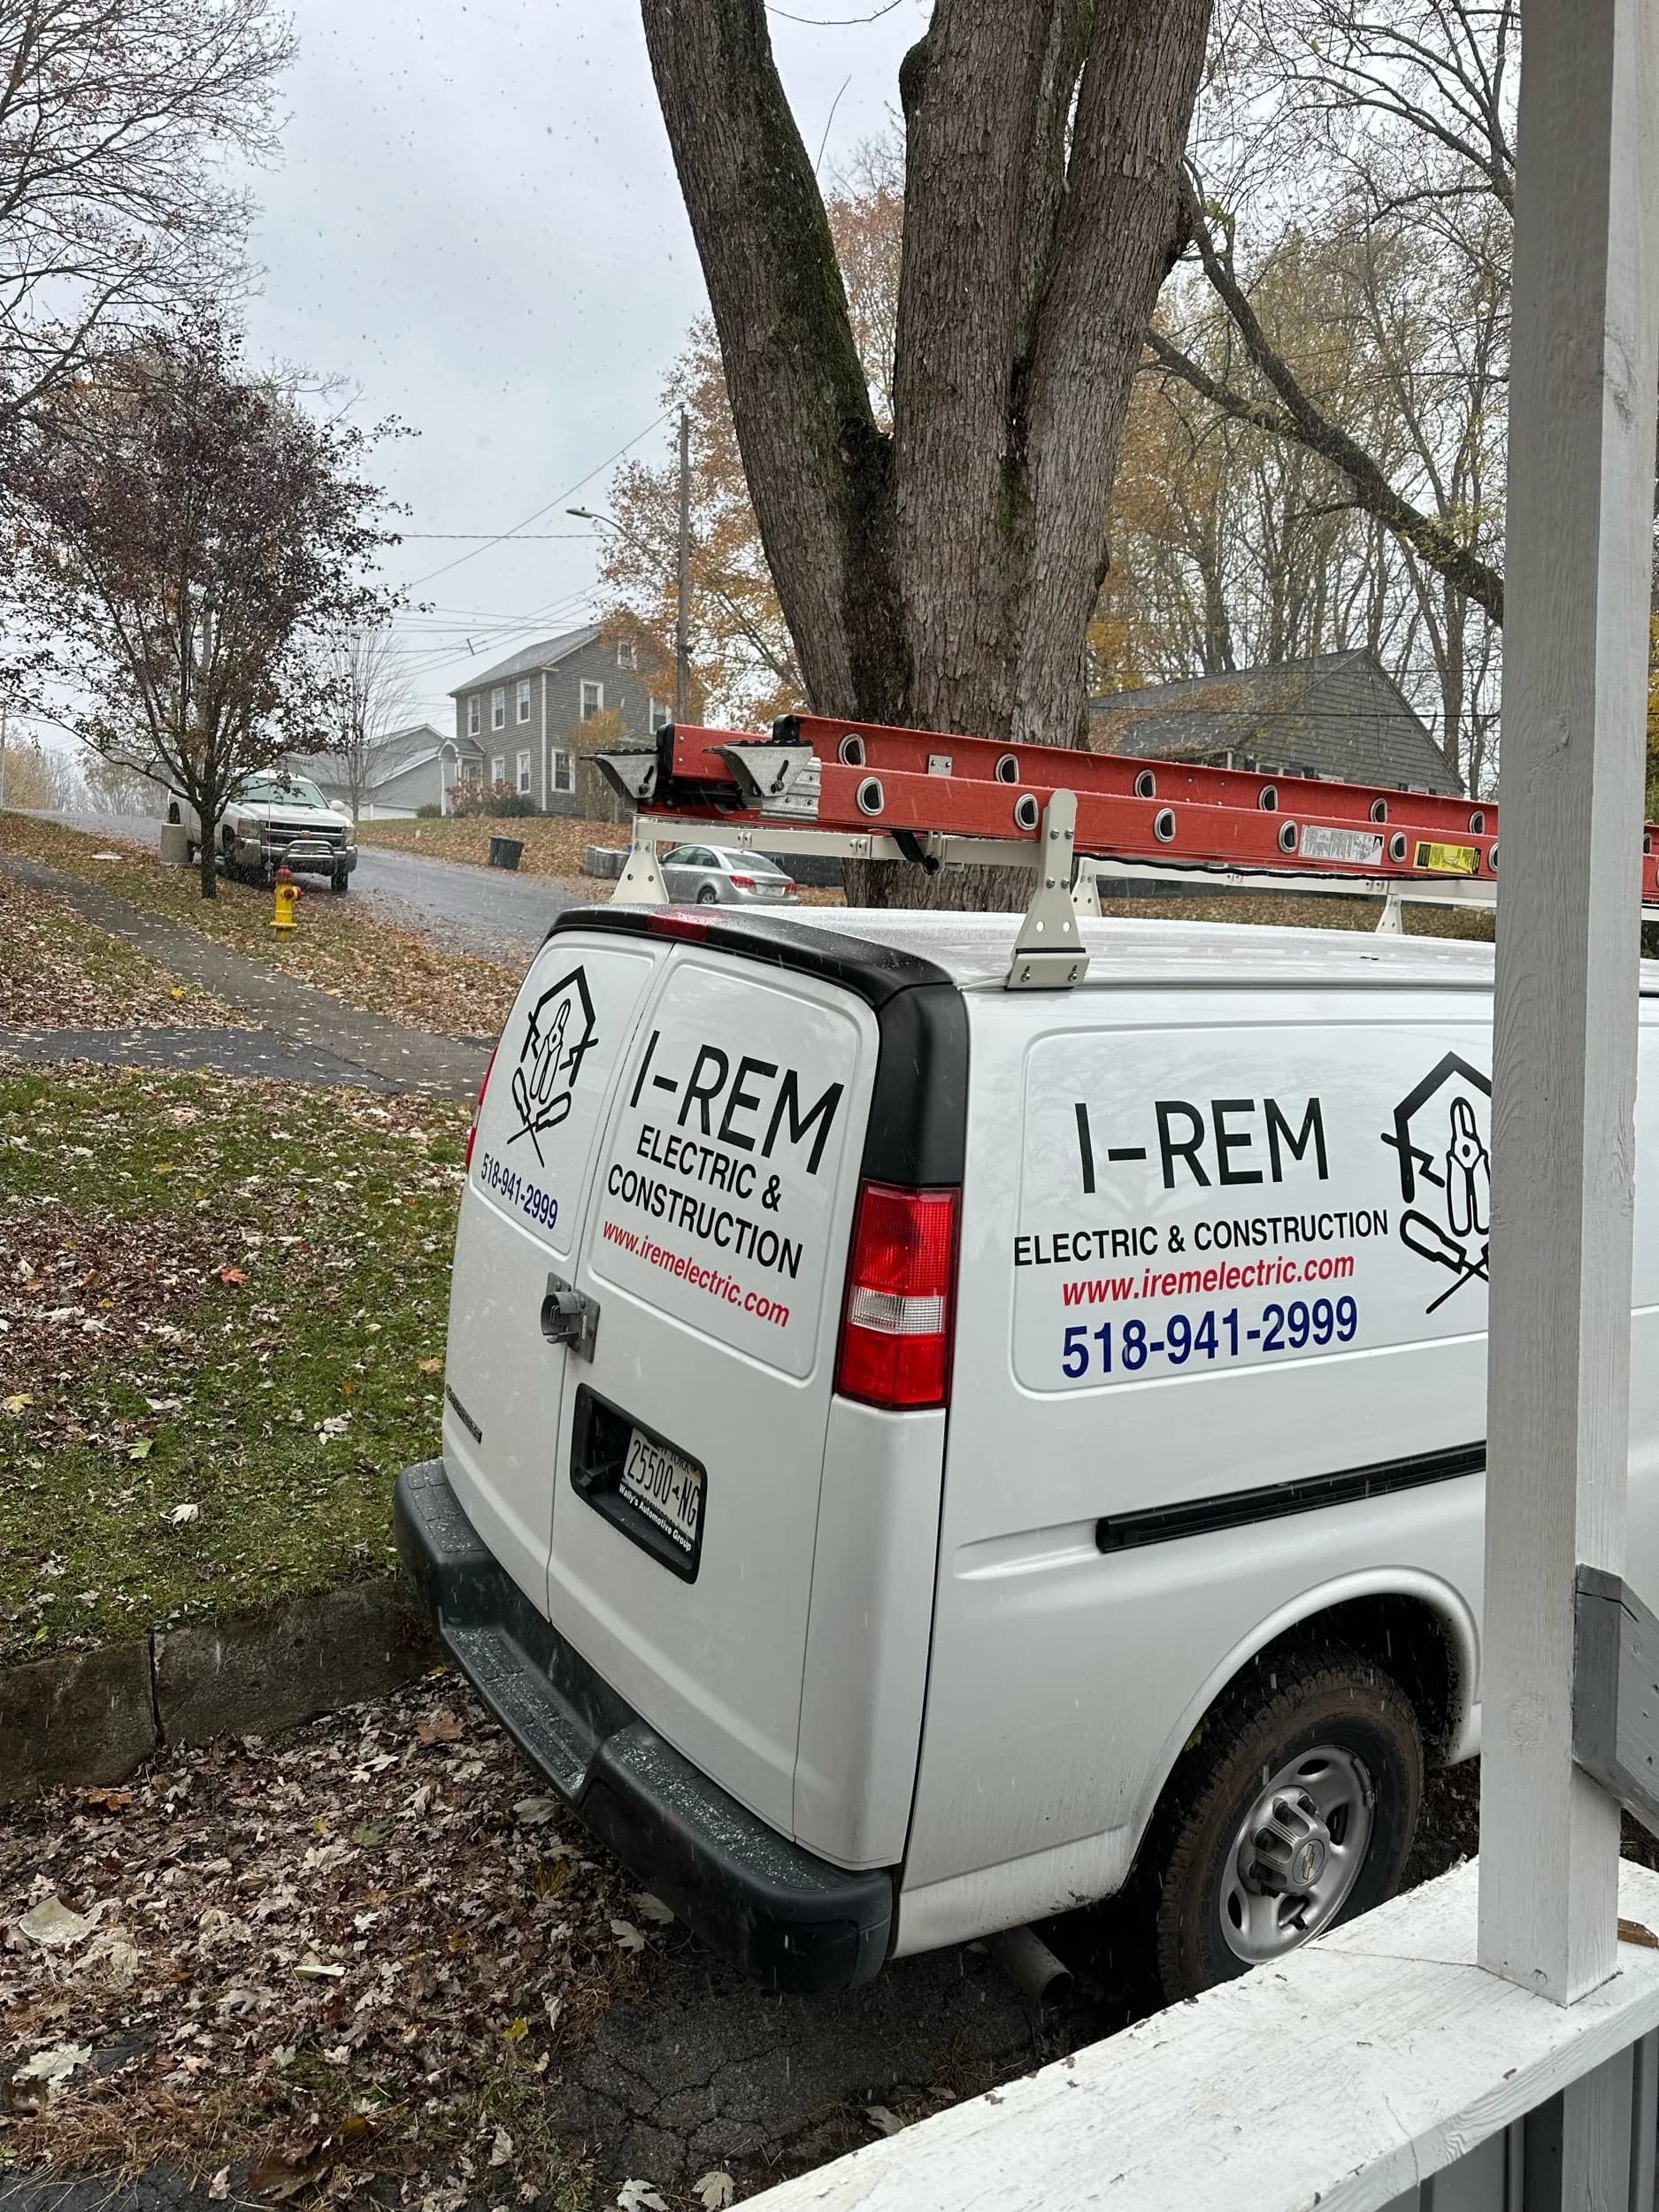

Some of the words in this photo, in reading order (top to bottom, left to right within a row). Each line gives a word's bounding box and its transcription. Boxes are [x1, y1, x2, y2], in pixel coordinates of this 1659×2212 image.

[629, 1030, 845, 1176] I-REM
[1074, 1097, 1329, 1194] I-REM
[480, 1152, 558, 1230] 518-941-2999
[636, 1125, 757, 1200] ELECTRIC
[761, 1174, 780, 1212] &
[608, 1164, 803, 1279] CONSTRUCTION
[1014, 1230, 1158, 1266] ELECTRIC
[1167, 1225, 1187, 1253] &
[1194, 1210, 1388, 1250] CONSTRUCTION
[603, 1220, 790, 1327] www.iremelectric.com
[1062, 1254, 1355, 1306] www.iremelectric.com
[1061, 1295, 1358, 1379] 518-941-2999
[639, 1501, 672, 1535] Automotive
[672, 1527, 692, 1552] Group
